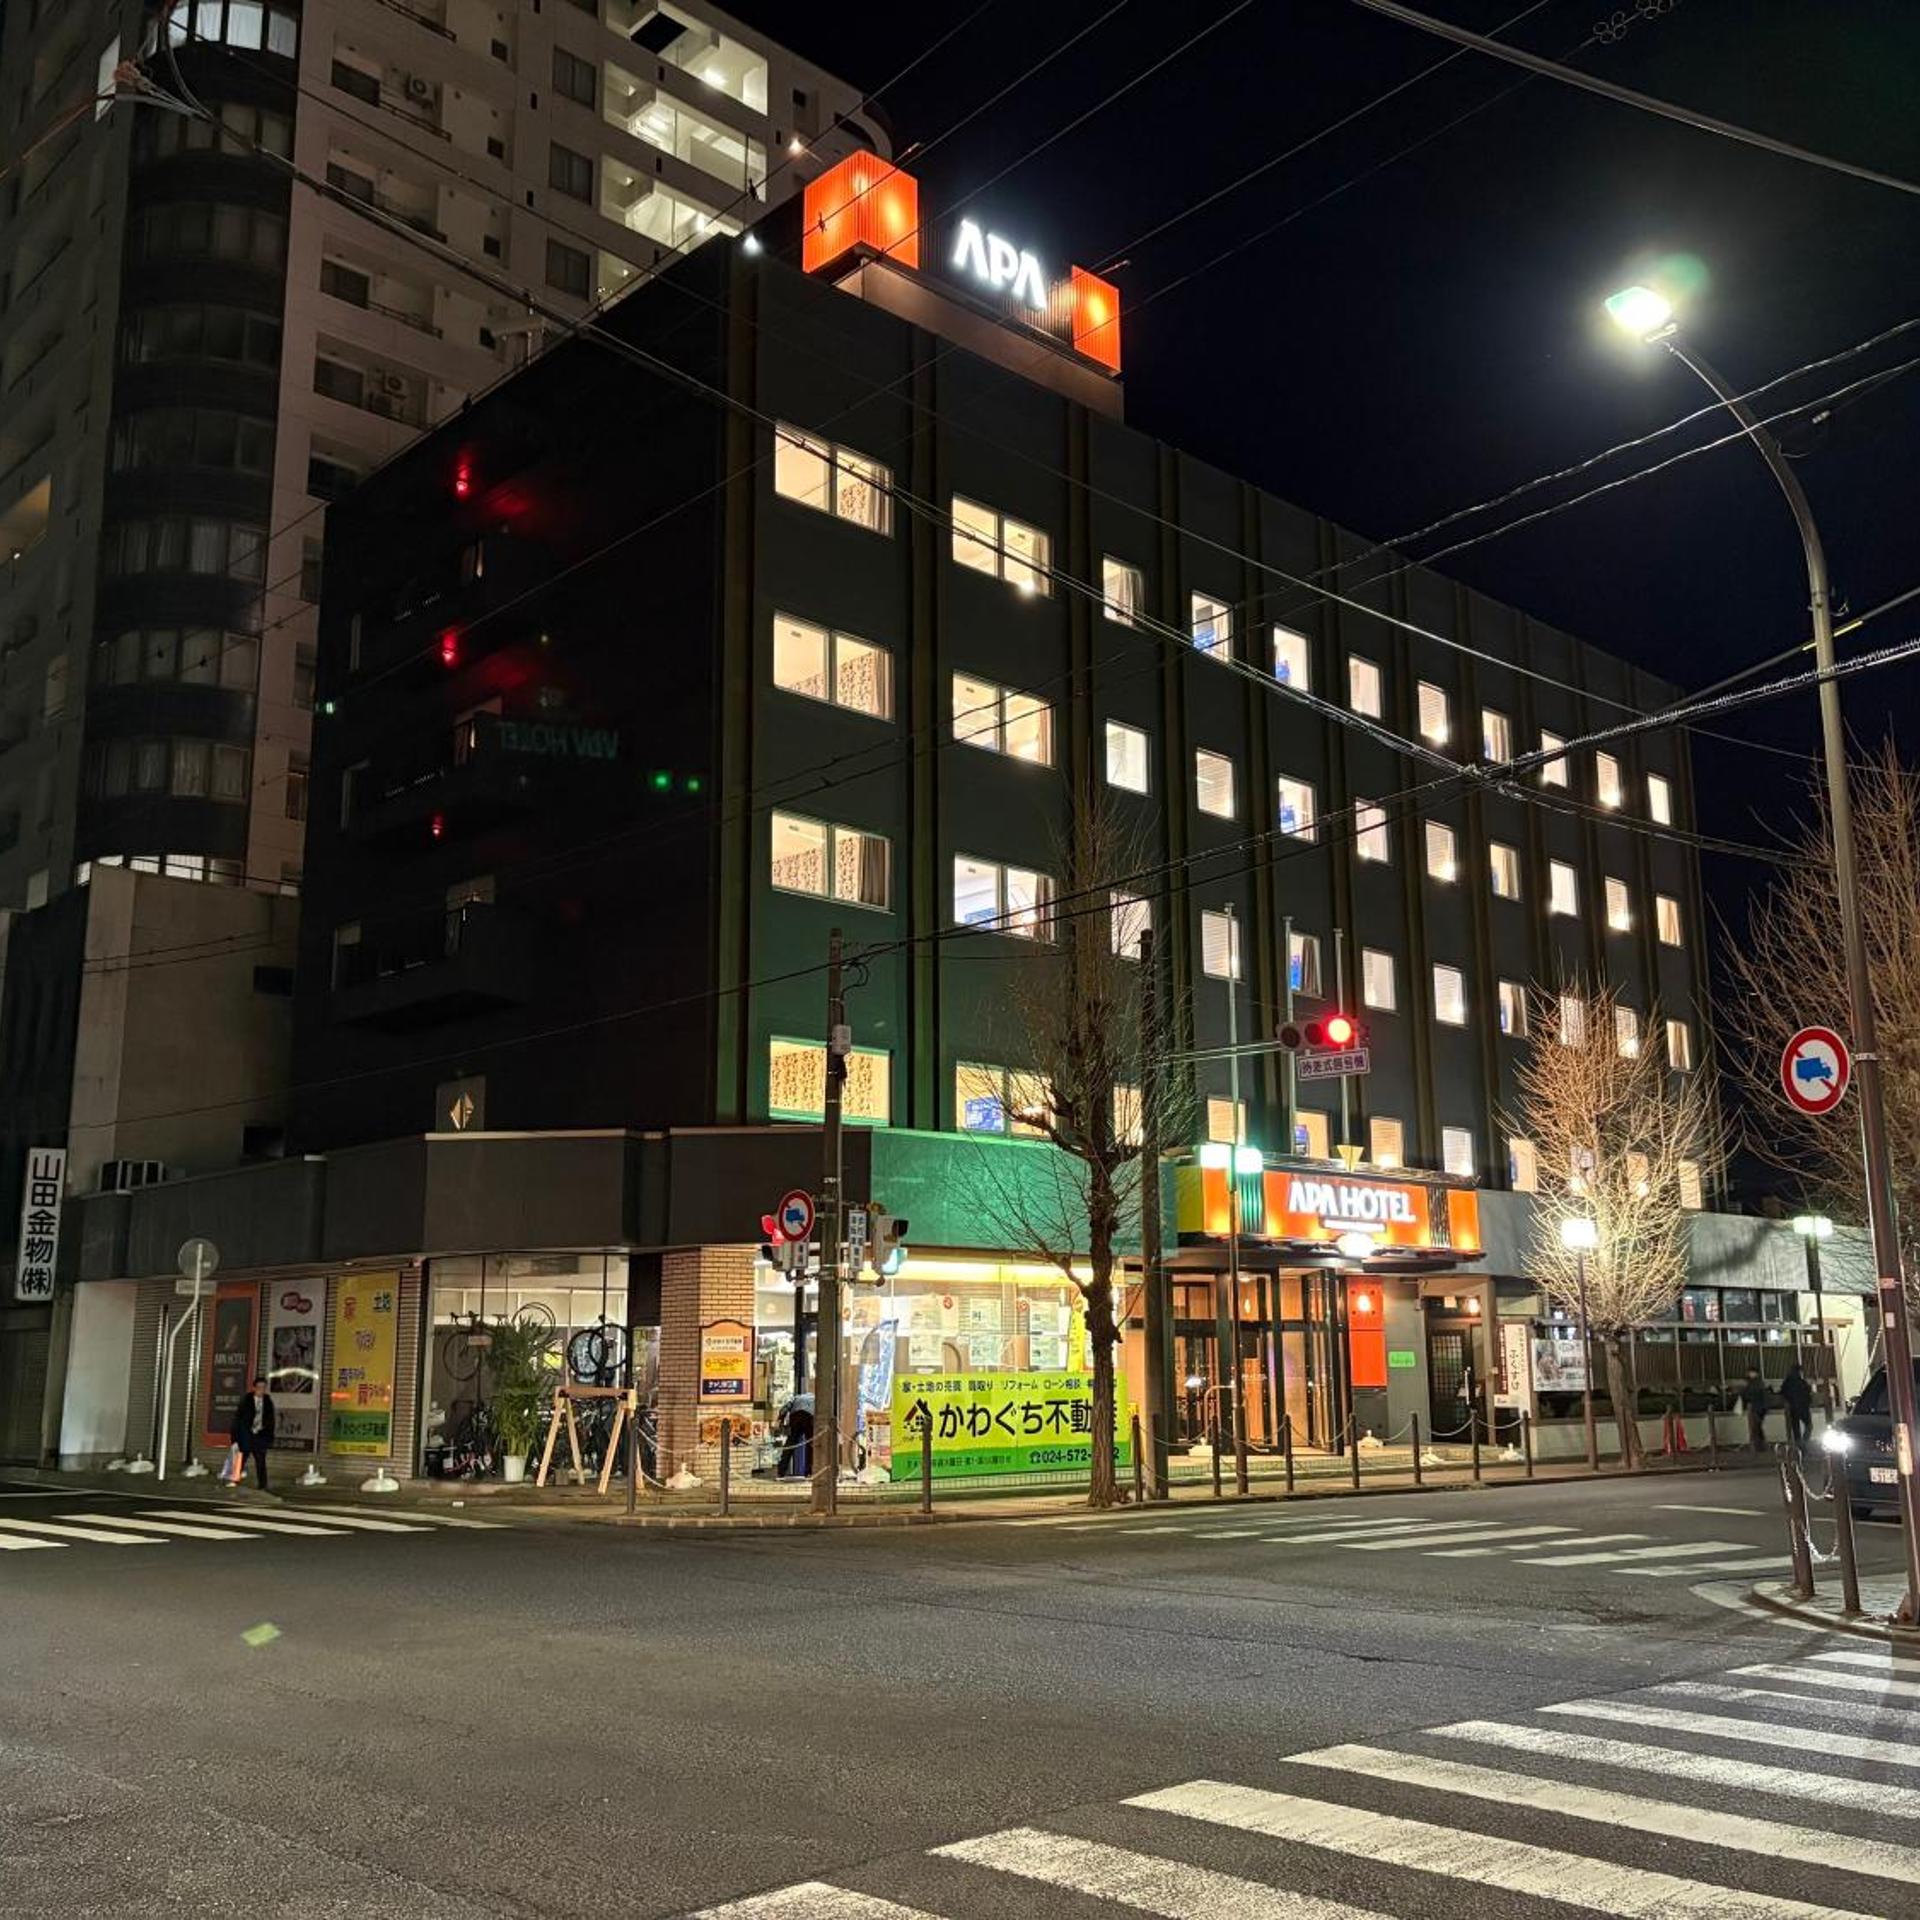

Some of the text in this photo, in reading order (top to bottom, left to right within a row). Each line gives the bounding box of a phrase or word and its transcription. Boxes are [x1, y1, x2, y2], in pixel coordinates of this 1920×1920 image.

[953, 219, 1047, 309] APA
[22, 1155, 61, 1295] 山田金物(株)
[1289, 1181, 1416, 1222] APA HOTEL
[939, 1398, 1117, 1438] かわぐち不動
